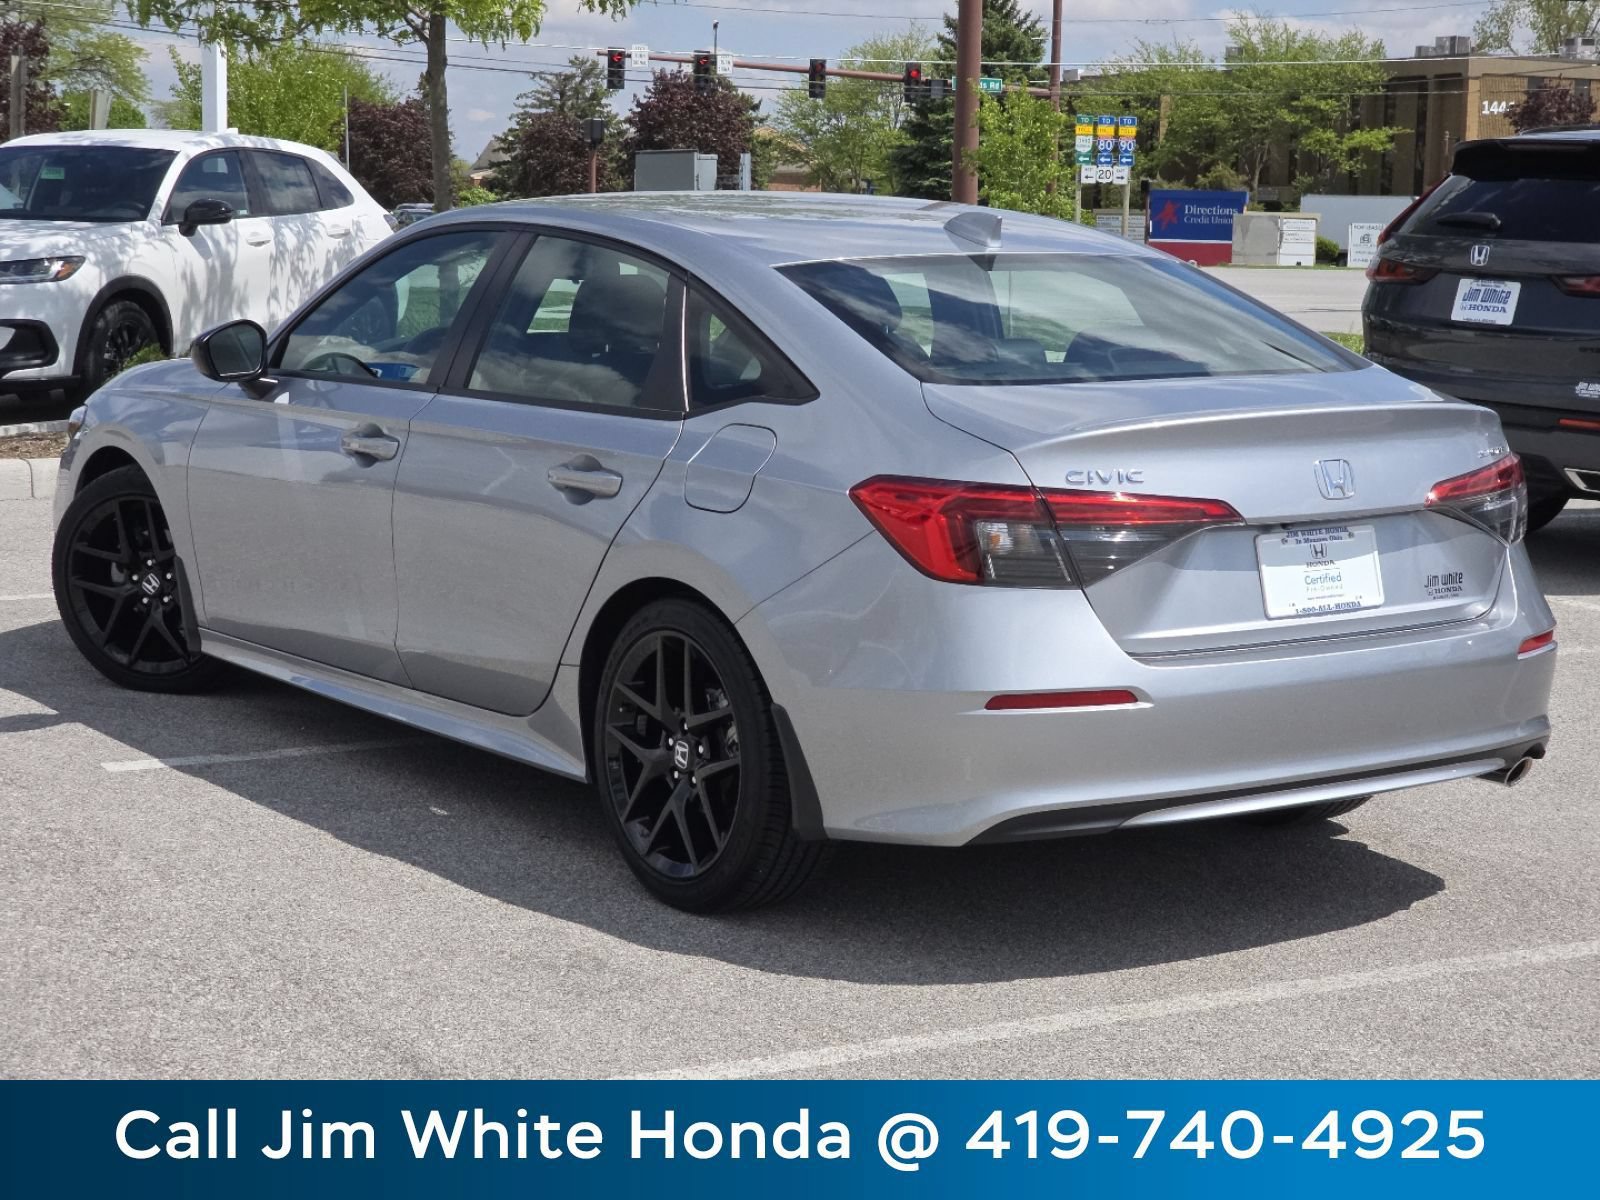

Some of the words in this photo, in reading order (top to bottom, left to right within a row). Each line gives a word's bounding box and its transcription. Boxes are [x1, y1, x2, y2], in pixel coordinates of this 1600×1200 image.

[1099, 140, 1113, 151] 80
[1120, 140, 1134, 151] 90
[1098, 169, 1112, 180] 20
[1184, 204, 1239, 216] Directions
[1183, 215, 1210, 225] Credit
[1467, 303, 1507, 313] HONDA
[1065, 468, 1145, 486] CIVIC
[1301, 528, 1324, 537] WHITE
[1306, 559, 1336, 568] HONDA
[1304, 571, 1342, 585] Certified
[1424, 574, 1440, 588] Jim
[1433, 586, 1463, 594] HONDA
